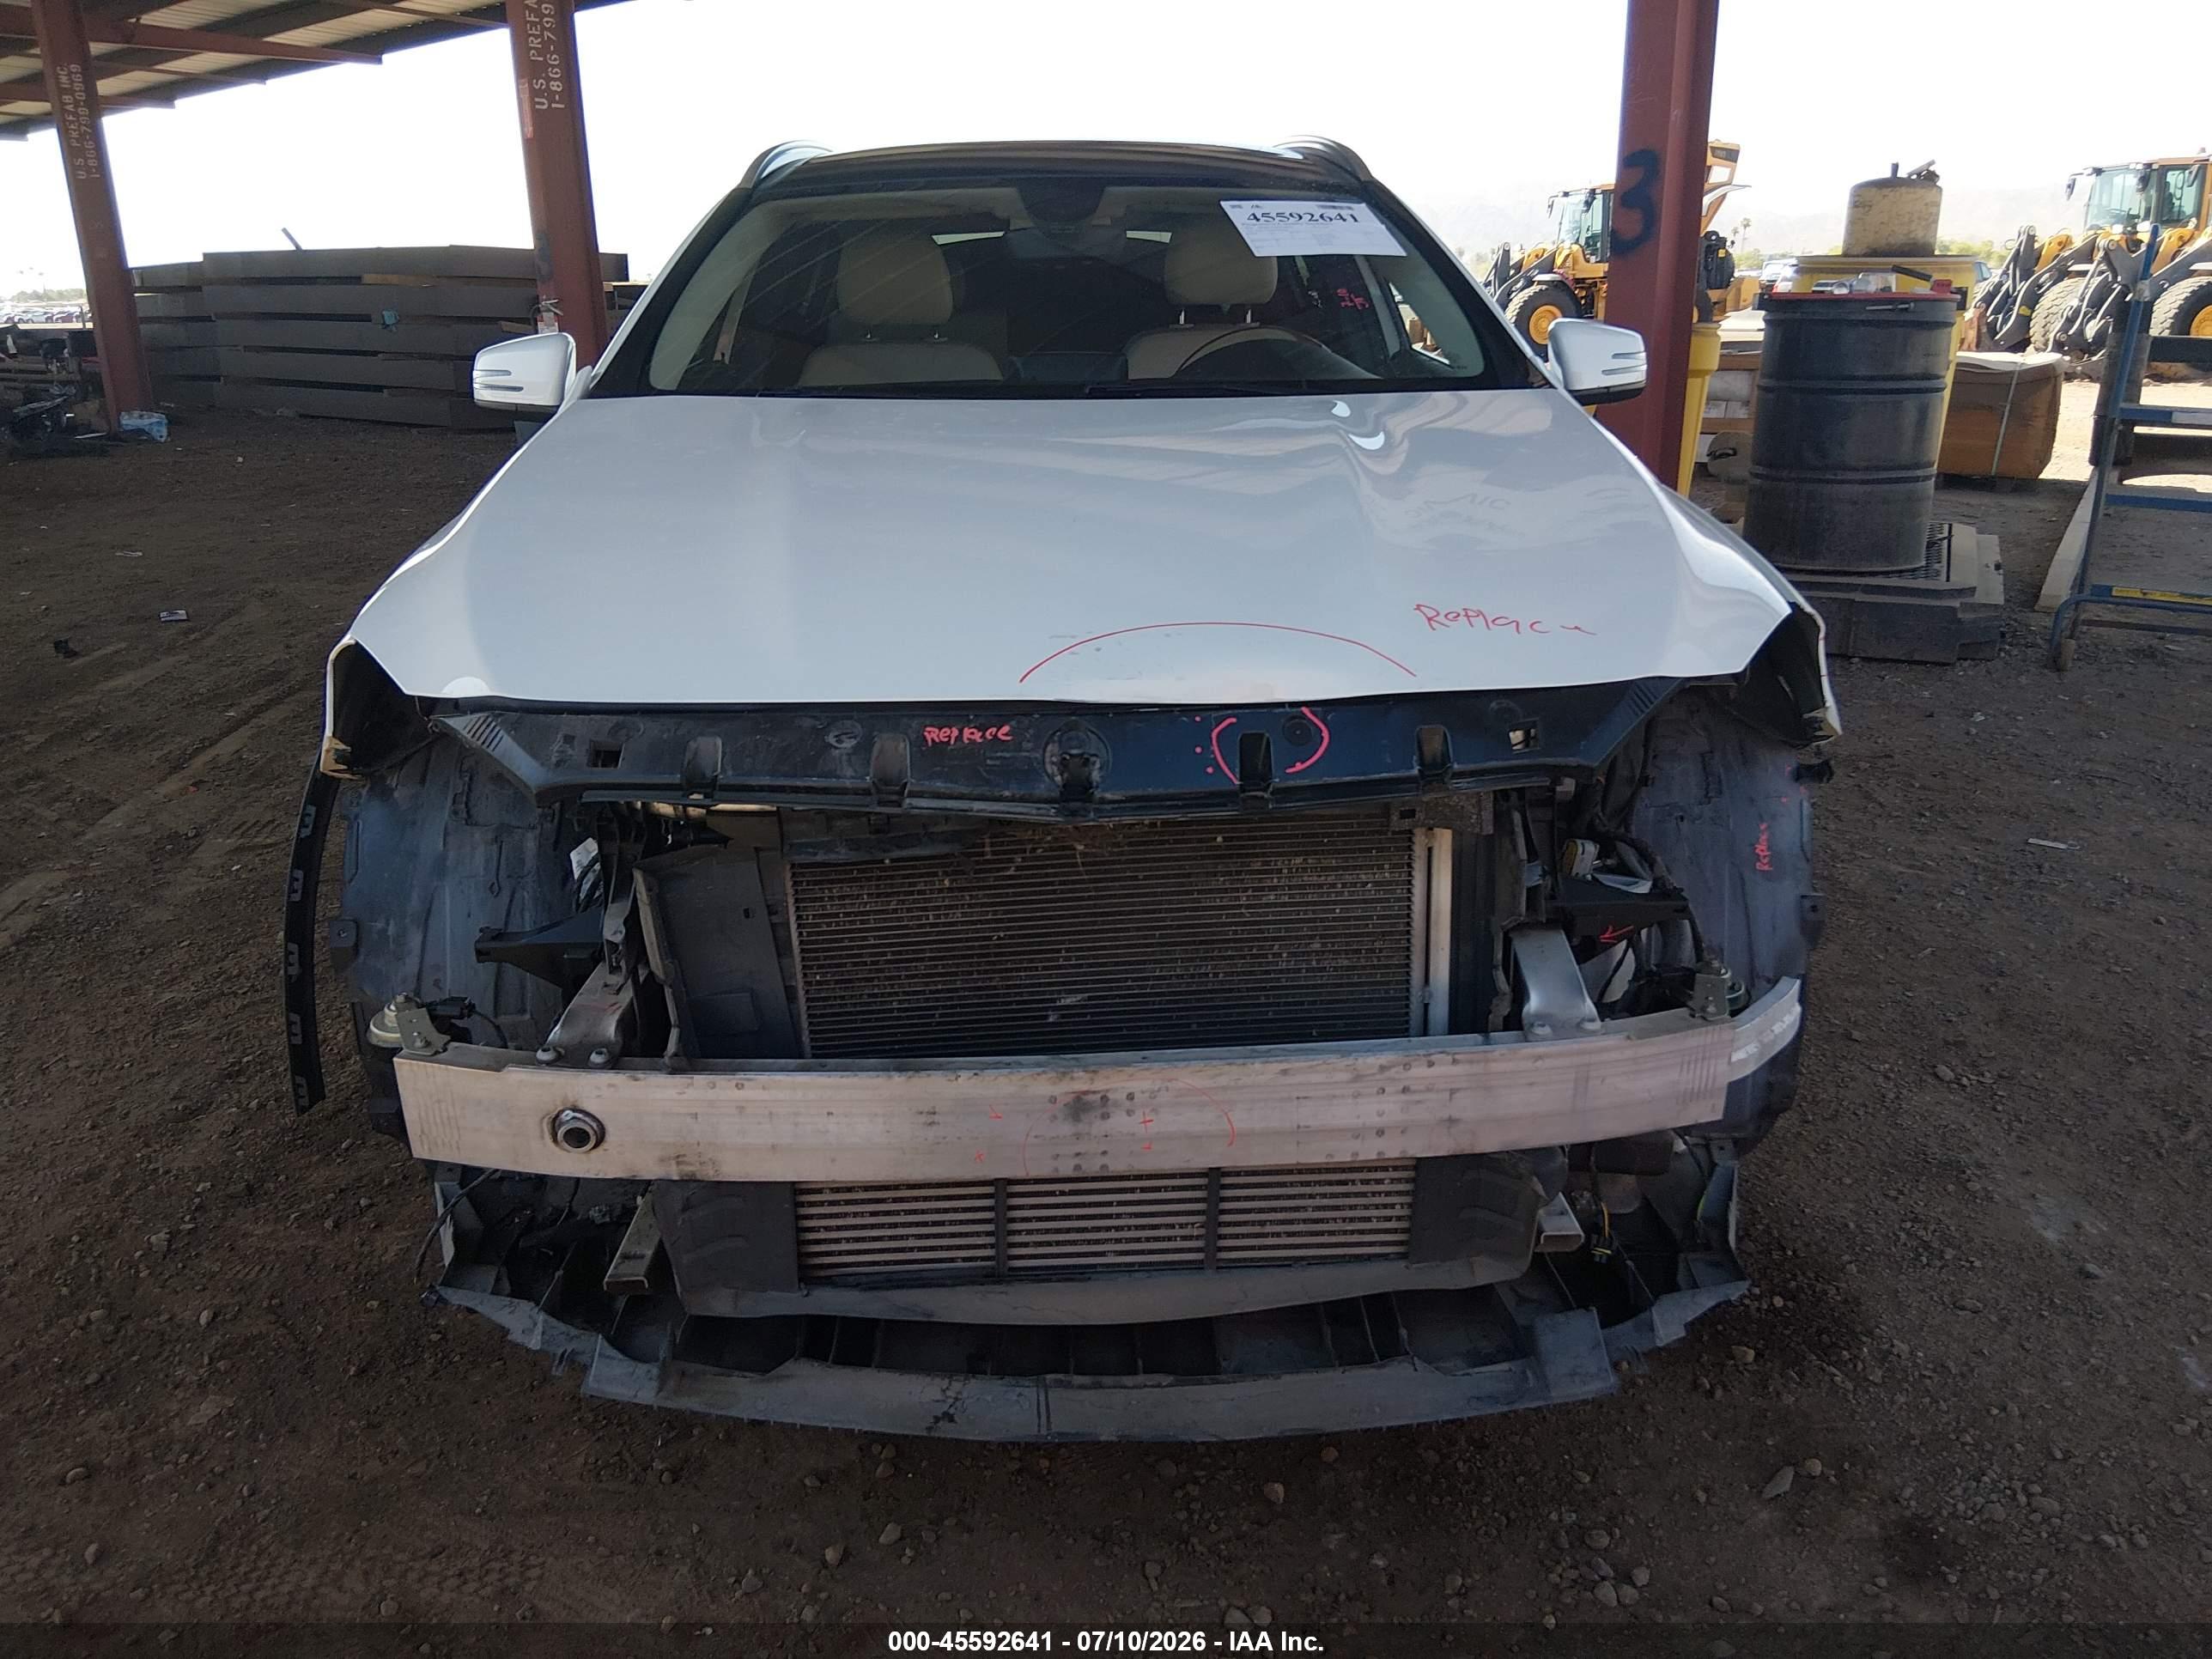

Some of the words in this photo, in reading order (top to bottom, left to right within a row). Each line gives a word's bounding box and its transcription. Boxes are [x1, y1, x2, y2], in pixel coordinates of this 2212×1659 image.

[532, 73, 549, 110] U.S.
[62, 94, 82, 147] PREFAB
[1247, 211, 1359, 223] 45592641
[1610, 149, 1659, 255] 3
